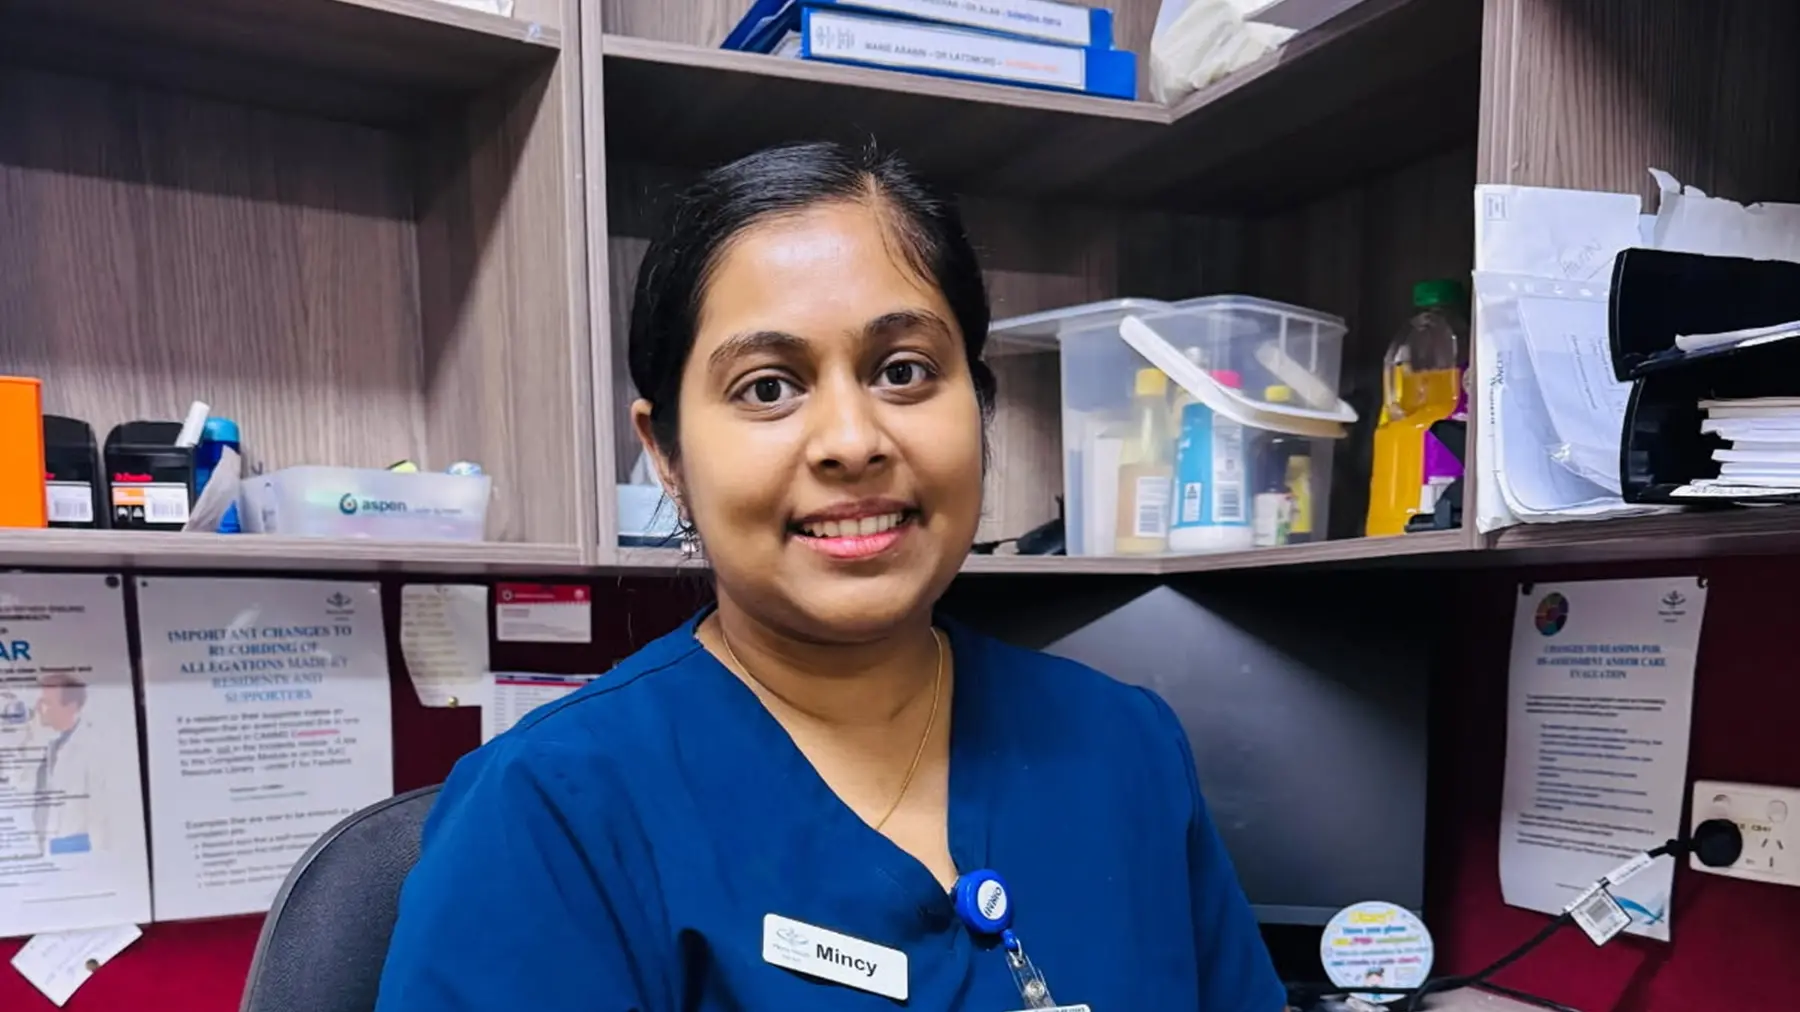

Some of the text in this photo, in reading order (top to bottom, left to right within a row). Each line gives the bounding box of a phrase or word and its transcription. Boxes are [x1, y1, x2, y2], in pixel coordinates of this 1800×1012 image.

[362, 500, 407, 513] aspen
[168, 625, 352, 644] IMPORTANT CHANGES TO
[208, 642, 319, 657] RECORDING OF
[180, 659, 284, 674] ALLEGATIONS
[212, 673, 323, 689] RESIDENTS AND
[225, 689, 313, 704] SUPPORTERS
[816, 943, 877, 977] Mincy
